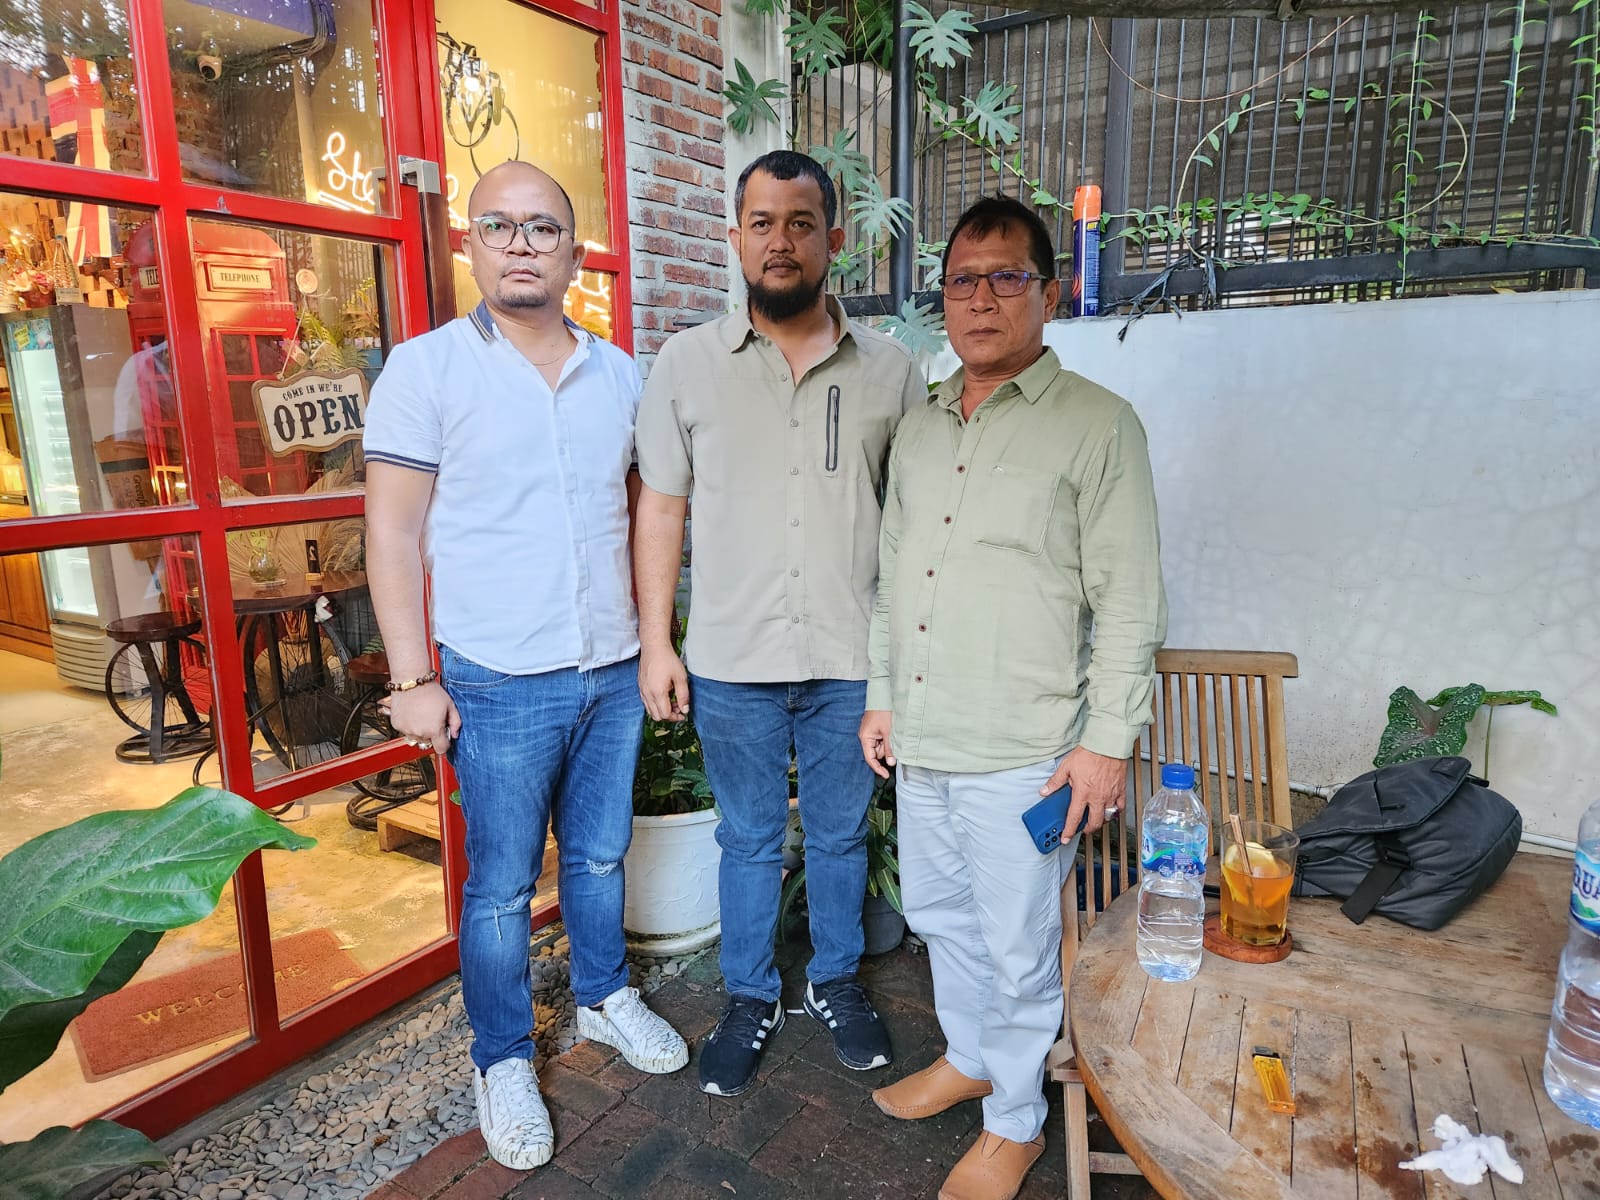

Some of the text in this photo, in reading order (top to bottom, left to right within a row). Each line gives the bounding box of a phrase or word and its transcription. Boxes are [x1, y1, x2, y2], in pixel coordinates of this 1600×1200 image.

[220, 271, 261, 284] TELEPHONE
[282, 381, 343, 401] COME IN WE'RE
[273, 393, 365, 442] OPEN
